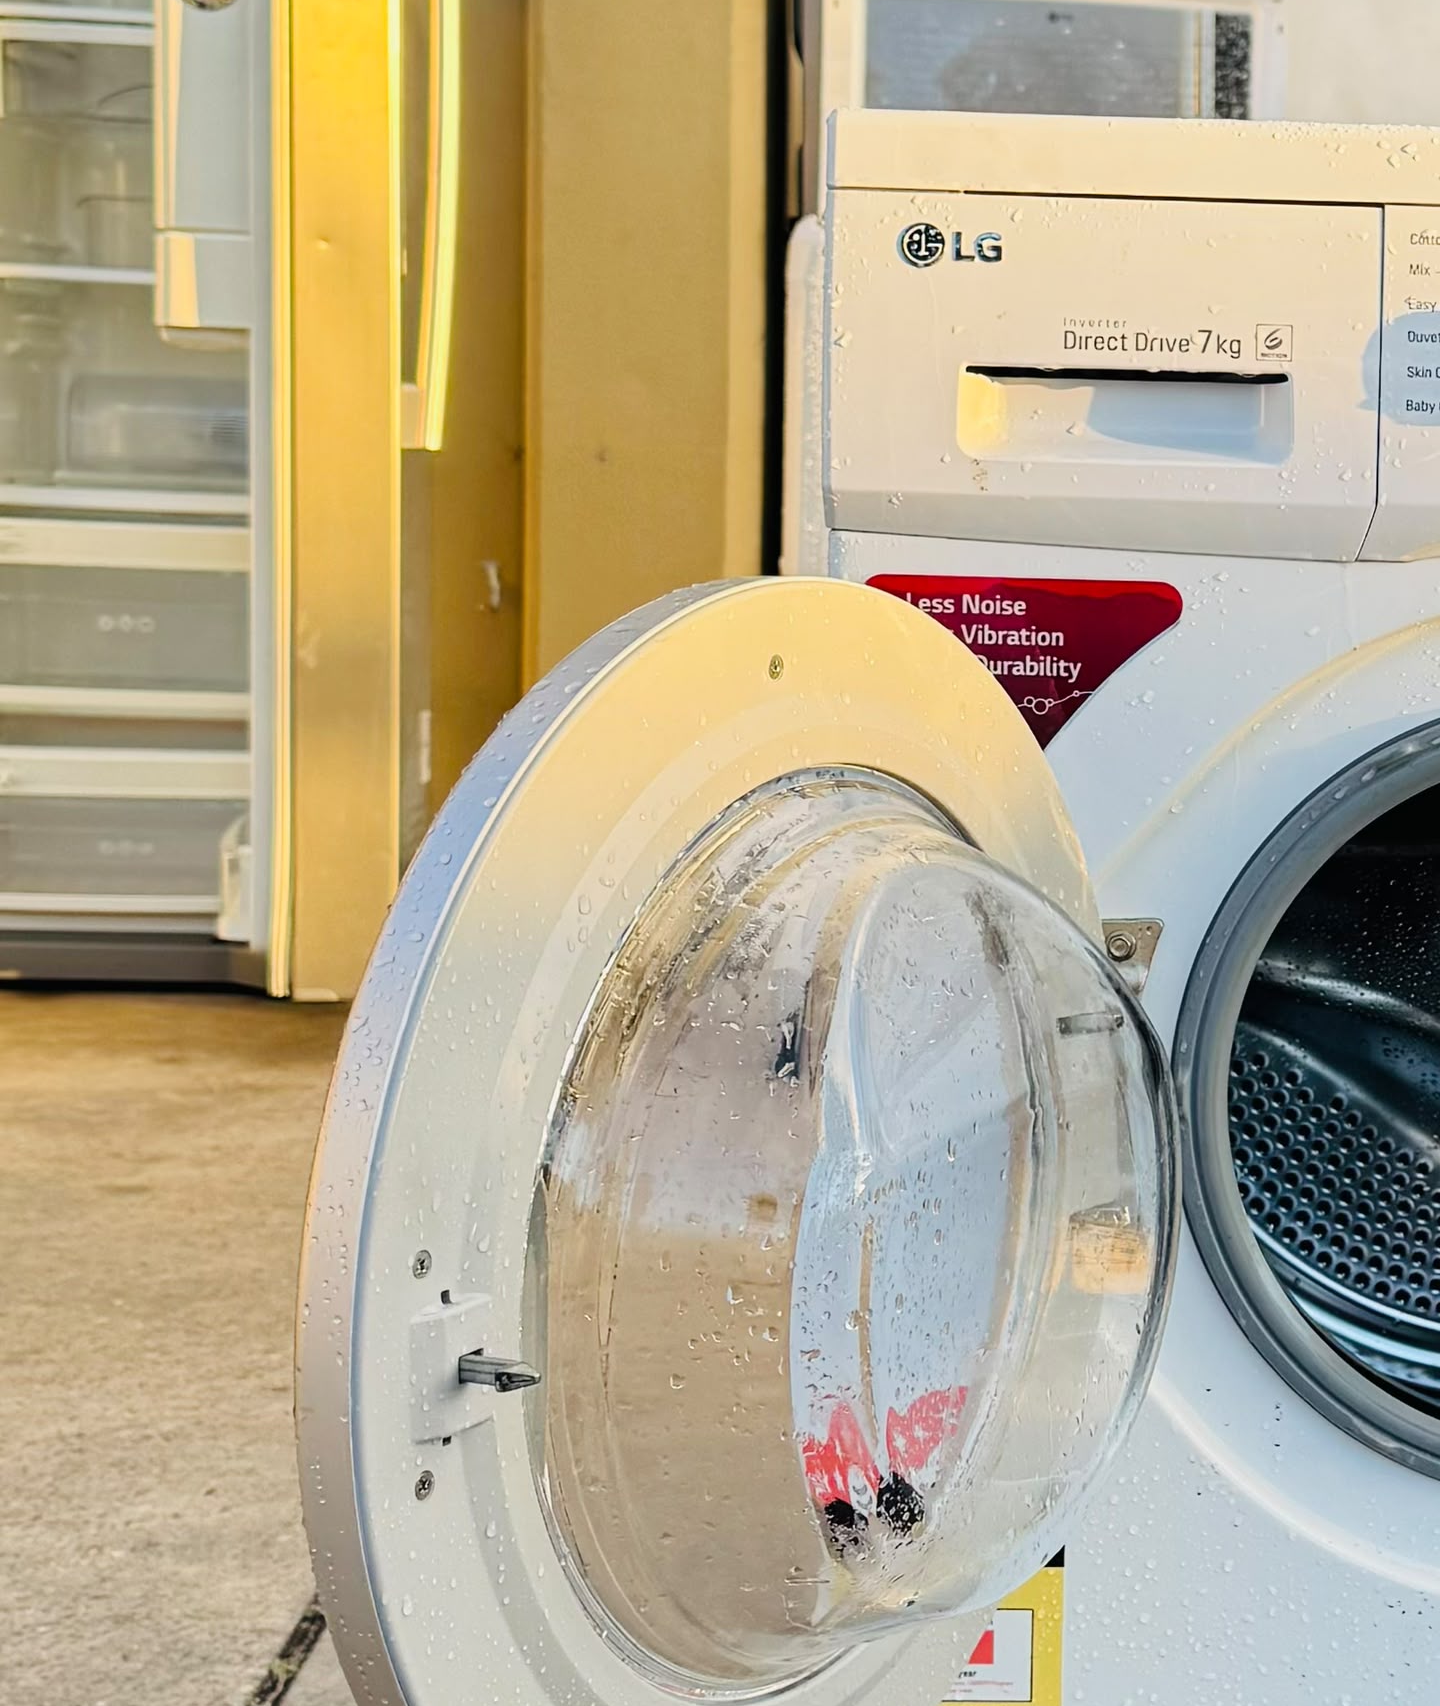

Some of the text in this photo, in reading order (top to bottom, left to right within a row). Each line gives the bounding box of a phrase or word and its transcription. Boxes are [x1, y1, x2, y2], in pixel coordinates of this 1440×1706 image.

[951, 231, 1002, 262] LG
[1409, 263, 1431, 276] Mix
[1408, 297, 1437, 313] Easy
[1063, 317, 1128, 329] Inverter
[1063, 330, 1128, 352] Direct
[1134, 332, 1190, 353] Drive
[1407, 365, 1432, 379] Skin
[1406, 399, 1436, 414] Baby
[961, 594, 1027, 615] Noise
[960, 624, 1064, 646] Vibration
